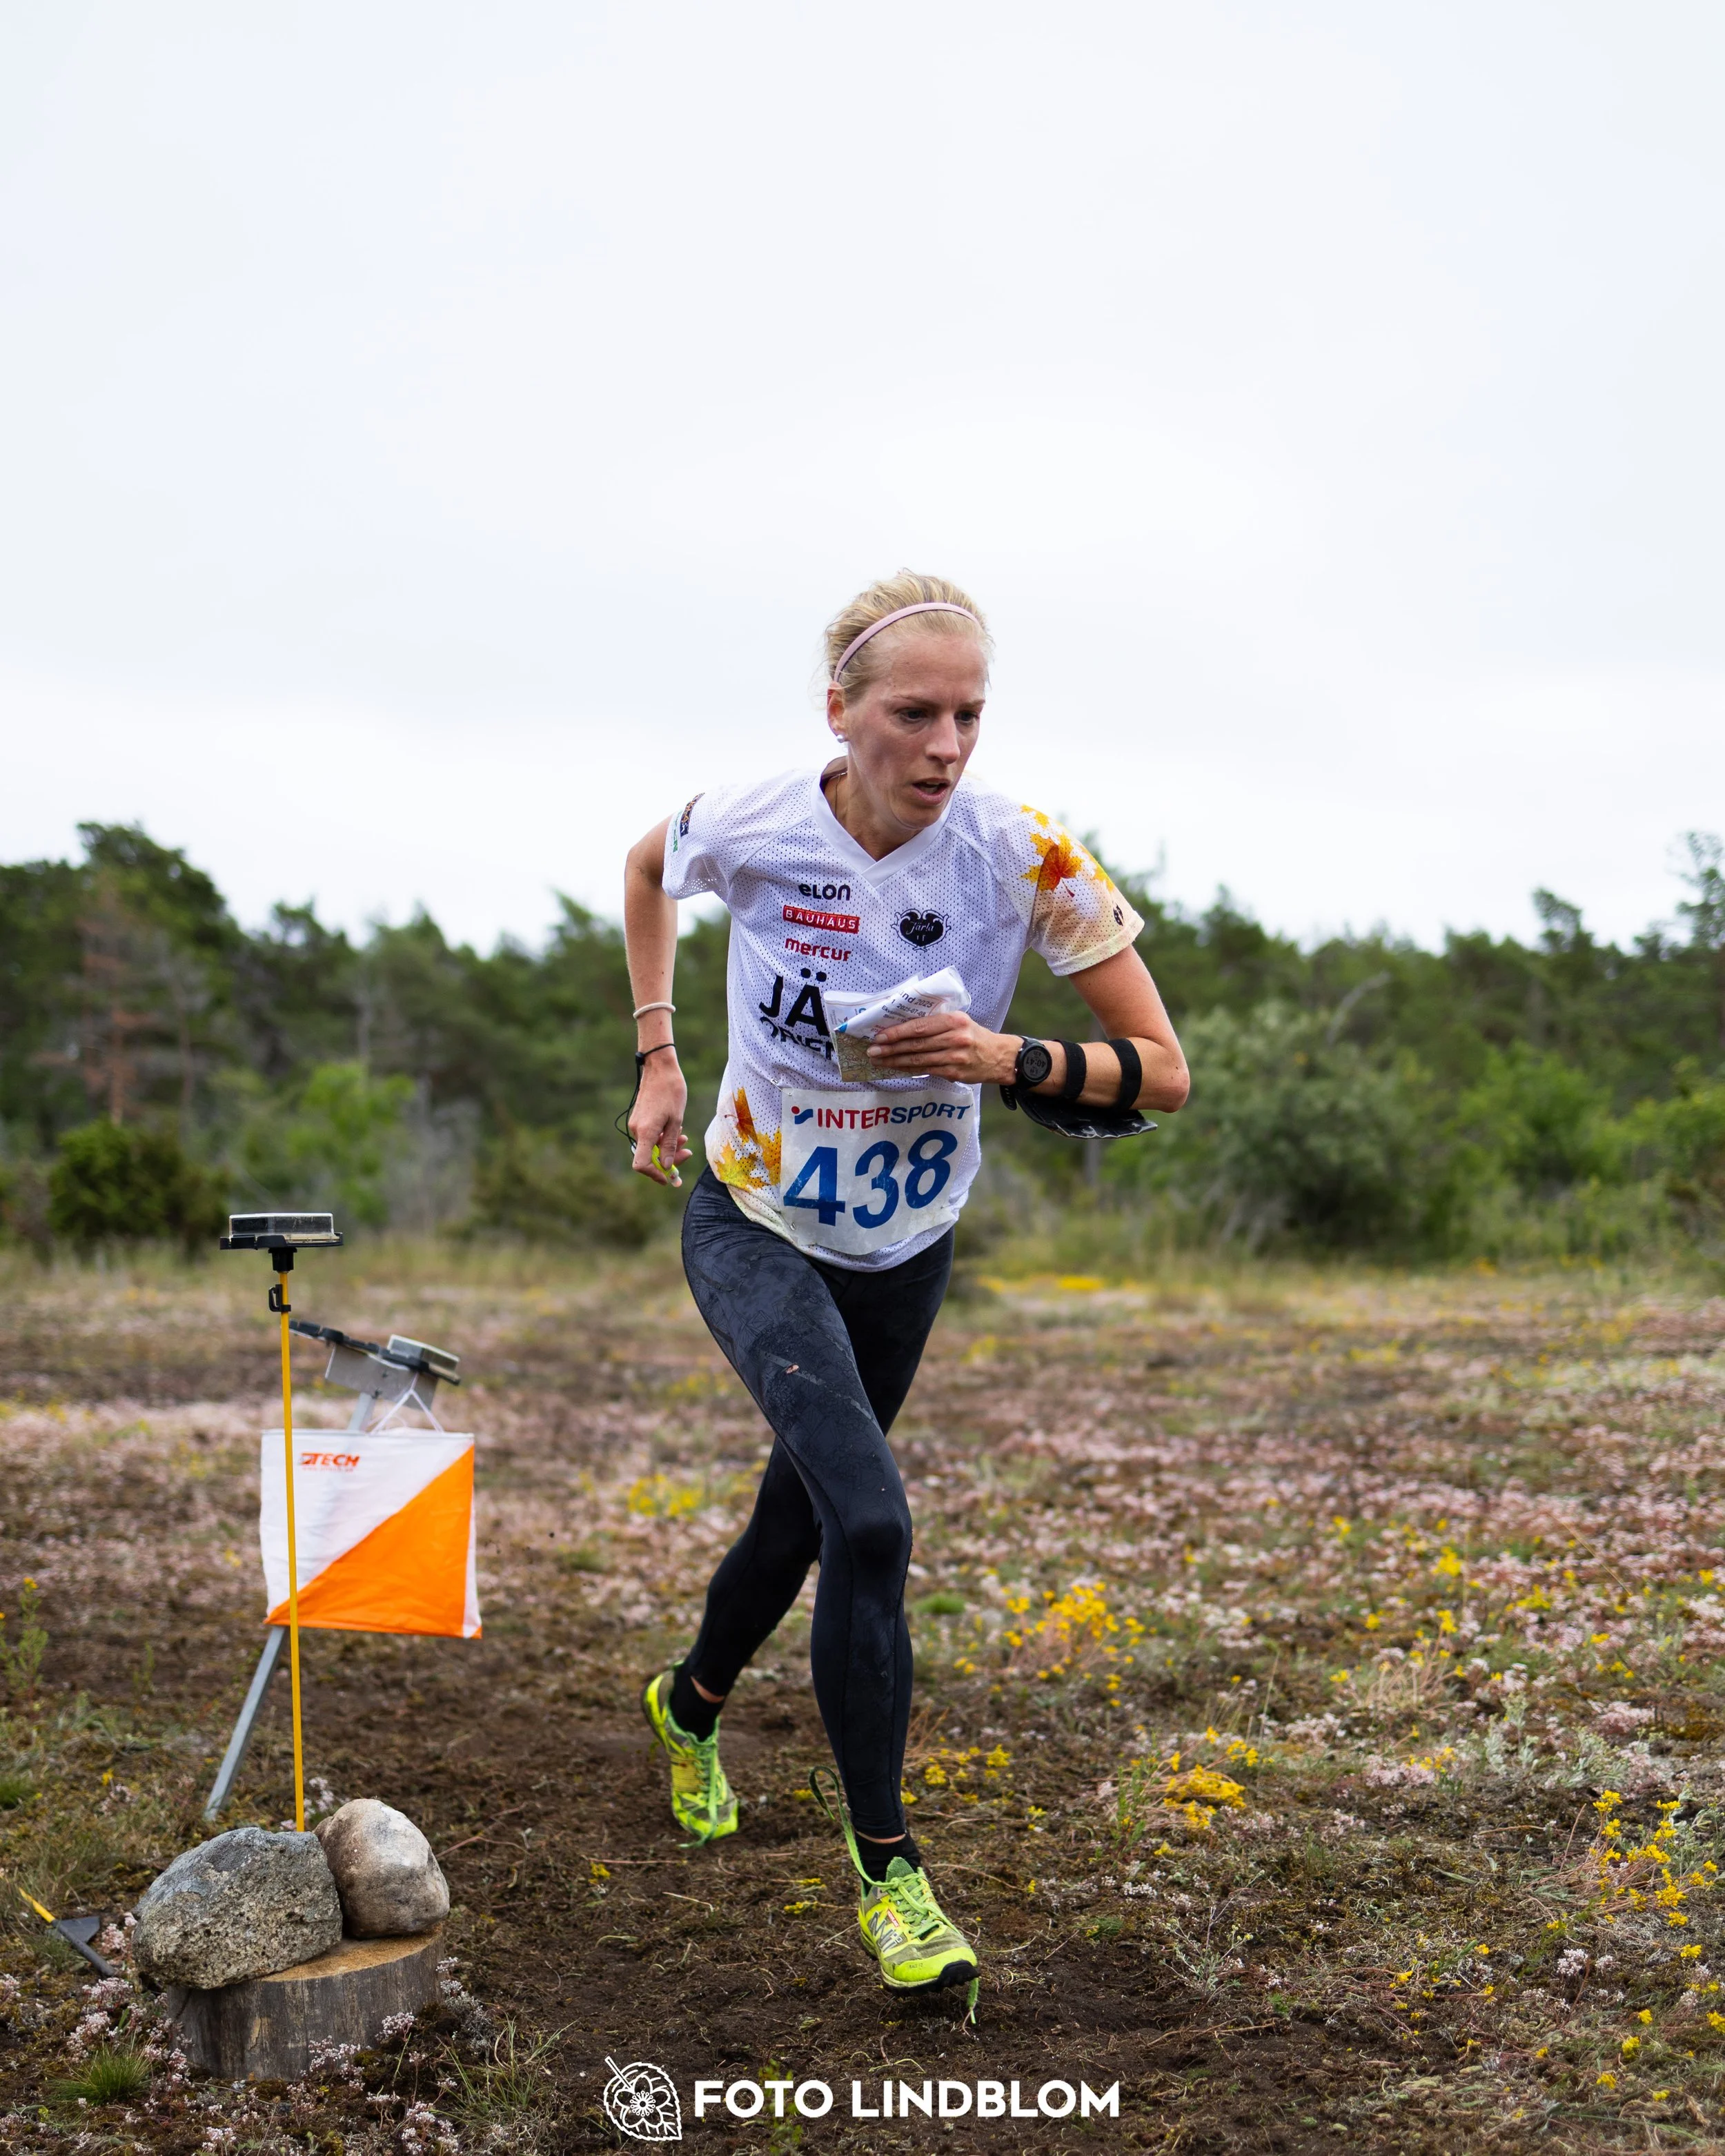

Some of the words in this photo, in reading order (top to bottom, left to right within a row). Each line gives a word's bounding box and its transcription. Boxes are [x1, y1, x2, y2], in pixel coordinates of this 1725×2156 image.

[785, 909, 856, 930] BAUHAUS
[905, 921, 934, 935] Järla
[785, 938, 851, 962] mercur
[897, 1003, 926, 1017] 2025-07-08
[914, 999, 935, 1009] 2025
[817, 1102, 971, 1129] INTERSPORT
[783, 1129, 958, 1229] 438
